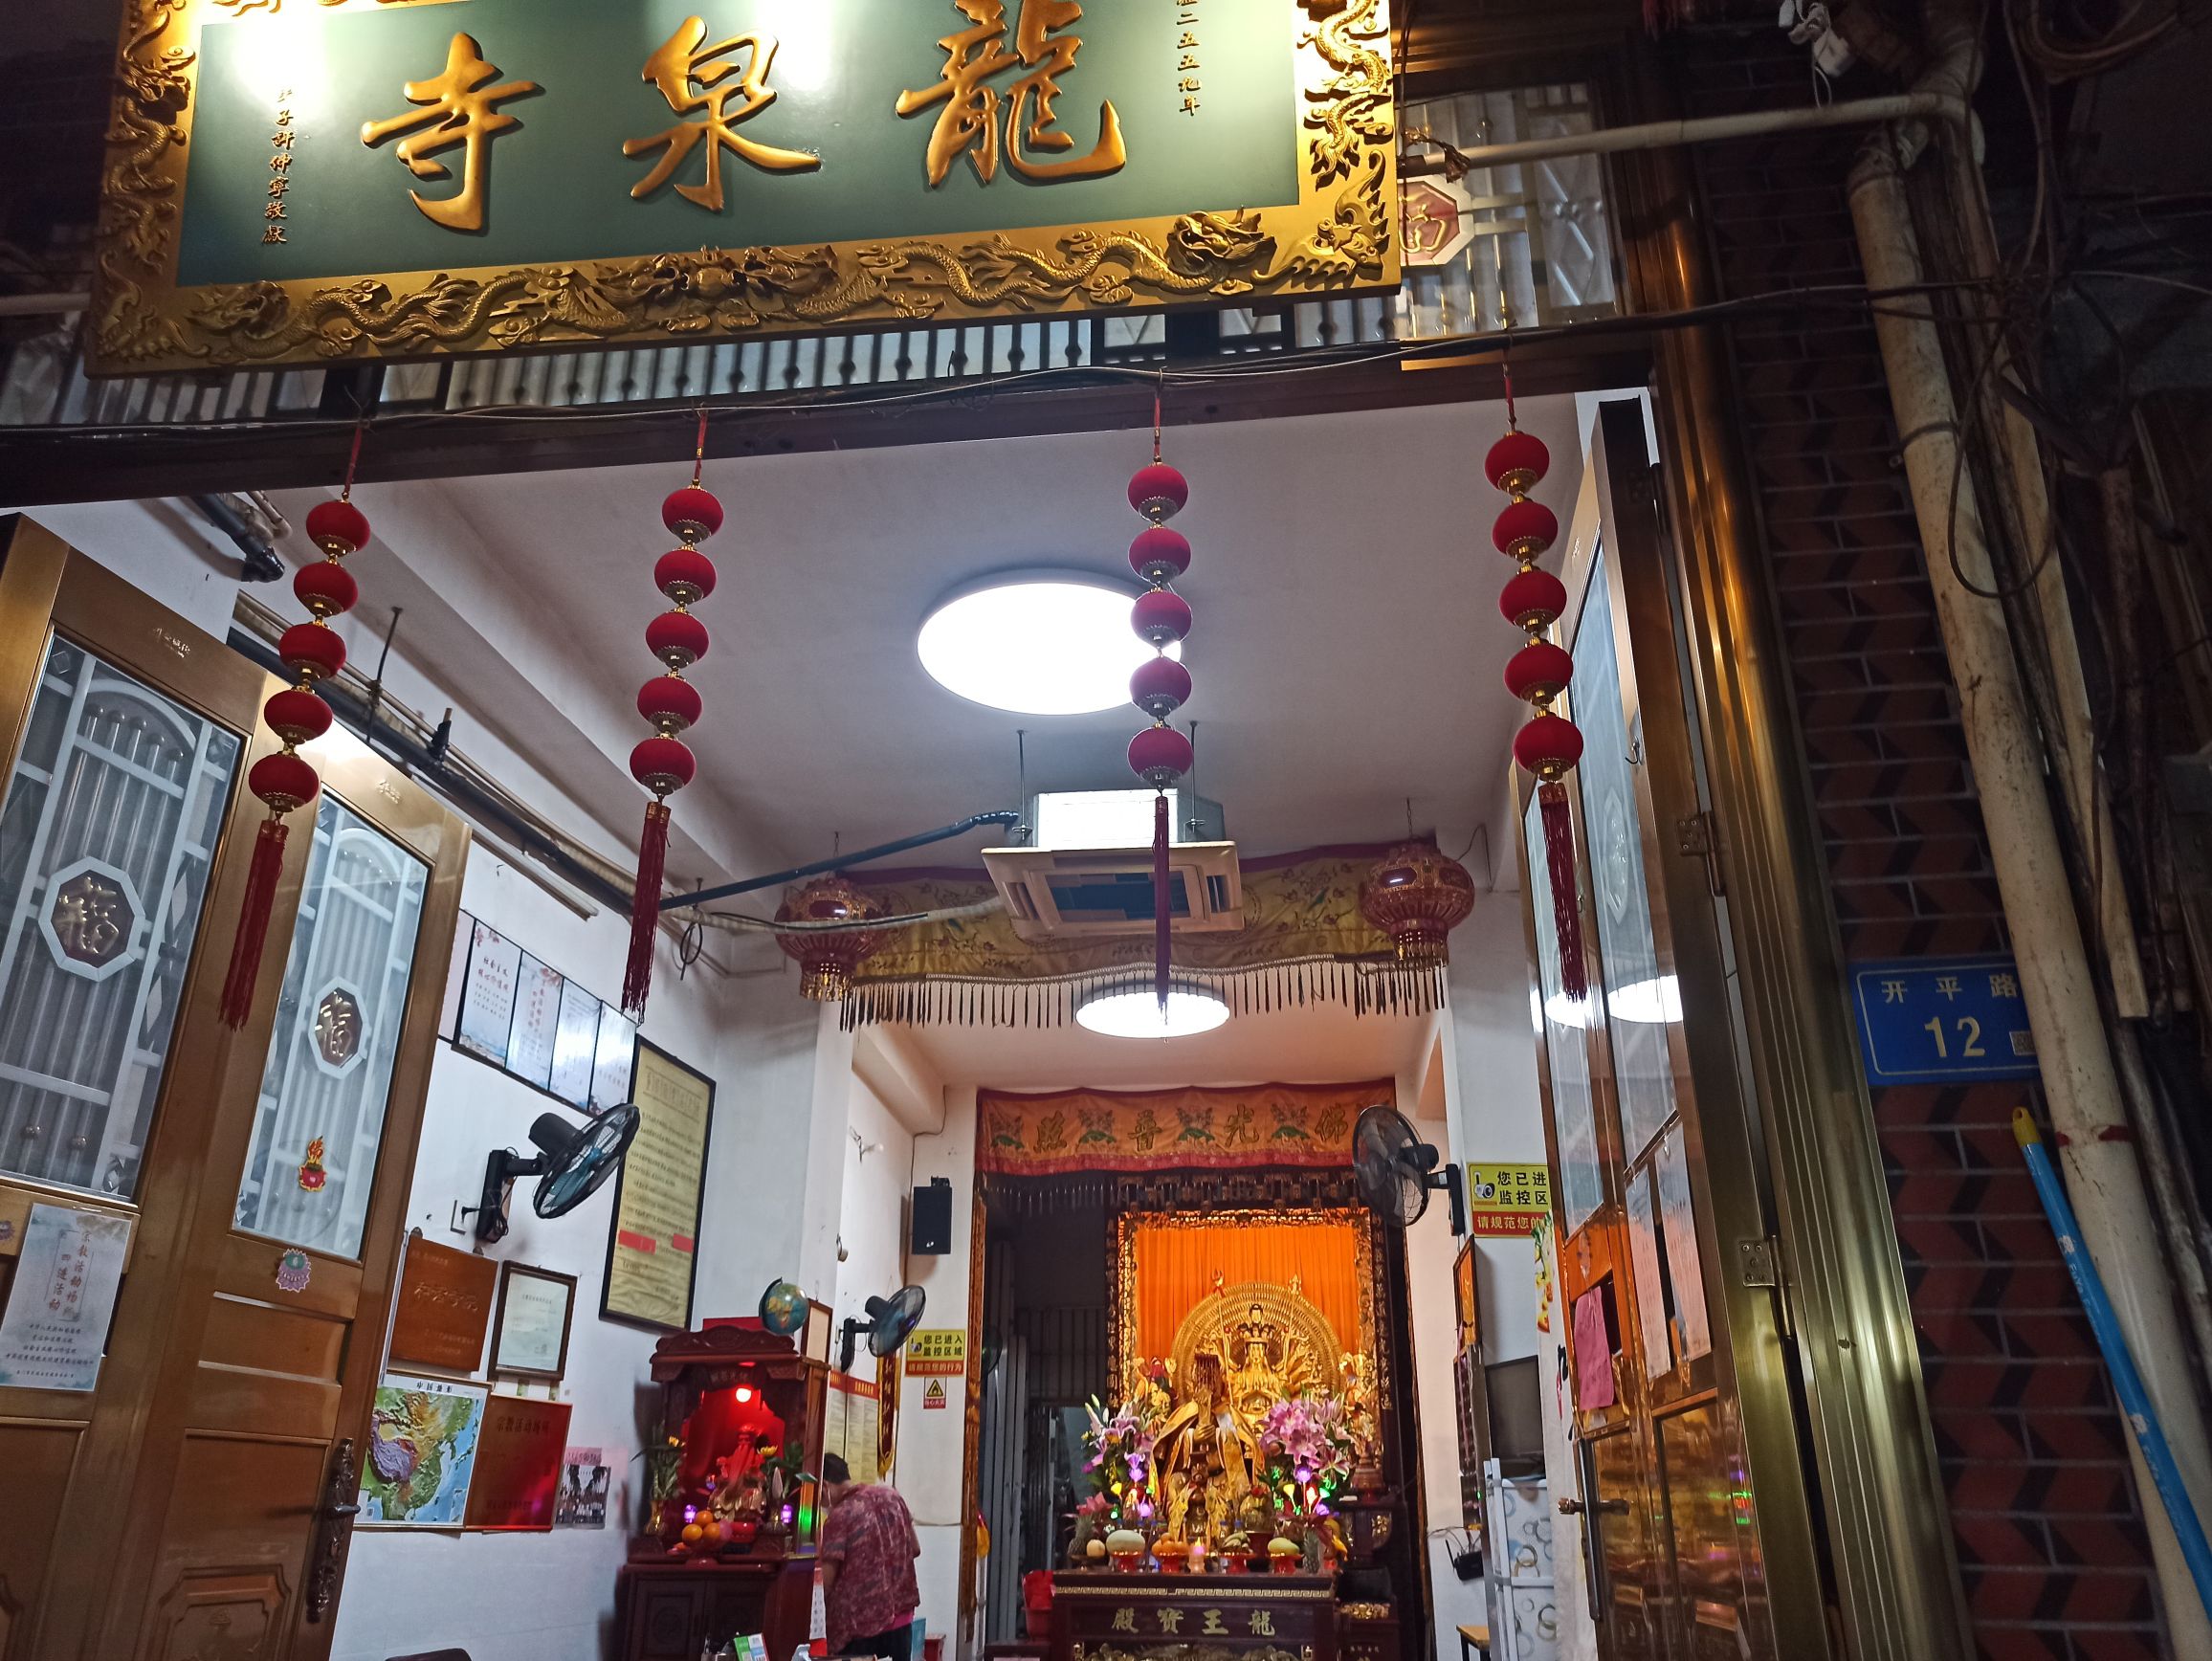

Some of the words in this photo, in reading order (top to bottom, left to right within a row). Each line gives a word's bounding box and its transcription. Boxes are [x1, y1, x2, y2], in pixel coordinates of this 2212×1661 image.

[360, 0, 1129, 232] 龍泉寺
[1881, 972, 2018, 1004] 开平路
[1924, 1016, 1985, 1058] 12
[1496, 1170, 1548, 1186] 您已进
[1498, 1190, 1548, 1206] 监控区
[923, 1335, 962, 1344] 您已进入
[1111, 1606, 1276, 1637] 龍王寶殿
